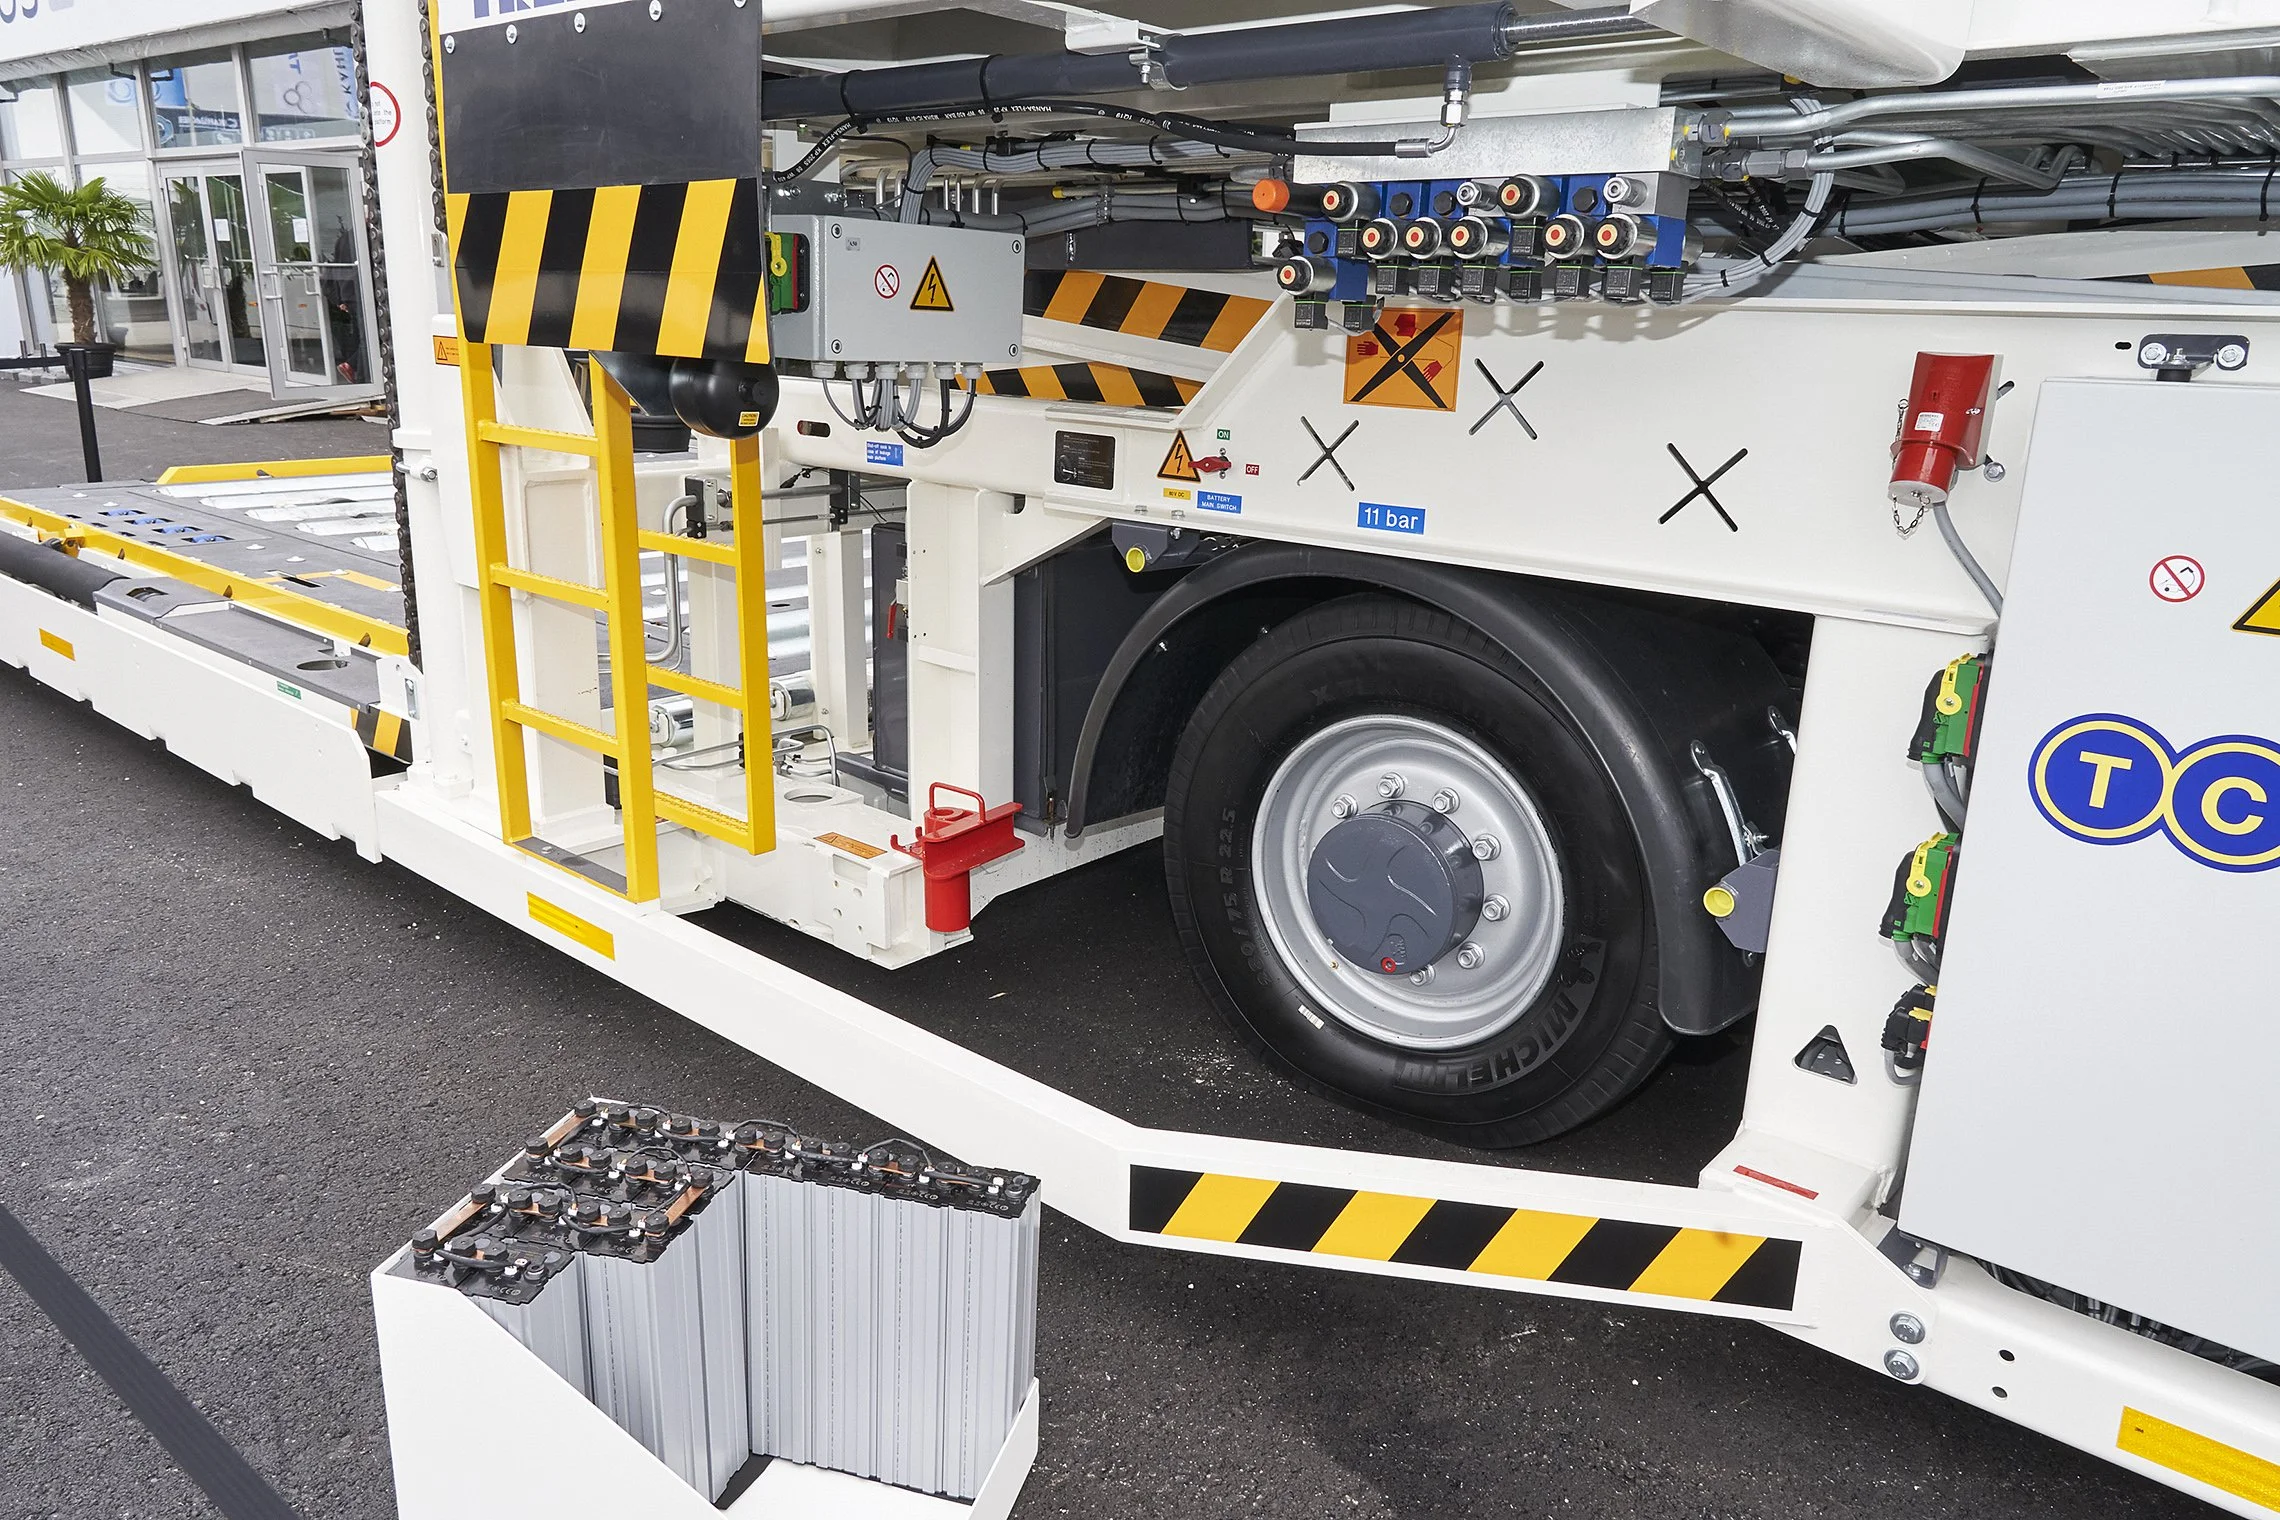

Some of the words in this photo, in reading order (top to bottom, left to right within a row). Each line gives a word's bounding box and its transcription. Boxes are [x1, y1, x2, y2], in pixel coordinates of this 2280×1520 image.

[1010, 105, 1052, 113] HANSA-FLEX
[822, 122, 852, 148] HANSA-FLEX
[1218, 430, 1229, 439] ON
[1246, 466, 1259, 474] OFF
[1216, 503, 1237, 511] SWITCH
[1364, 507, 1380, 525] 11
[1386, 509, 1419, 530] bar
[1219, 807, 1237, 858] 22.5
[1220, 866, 1233, 885] R
[1400, 992, 1579, 1090] MICHELIN
